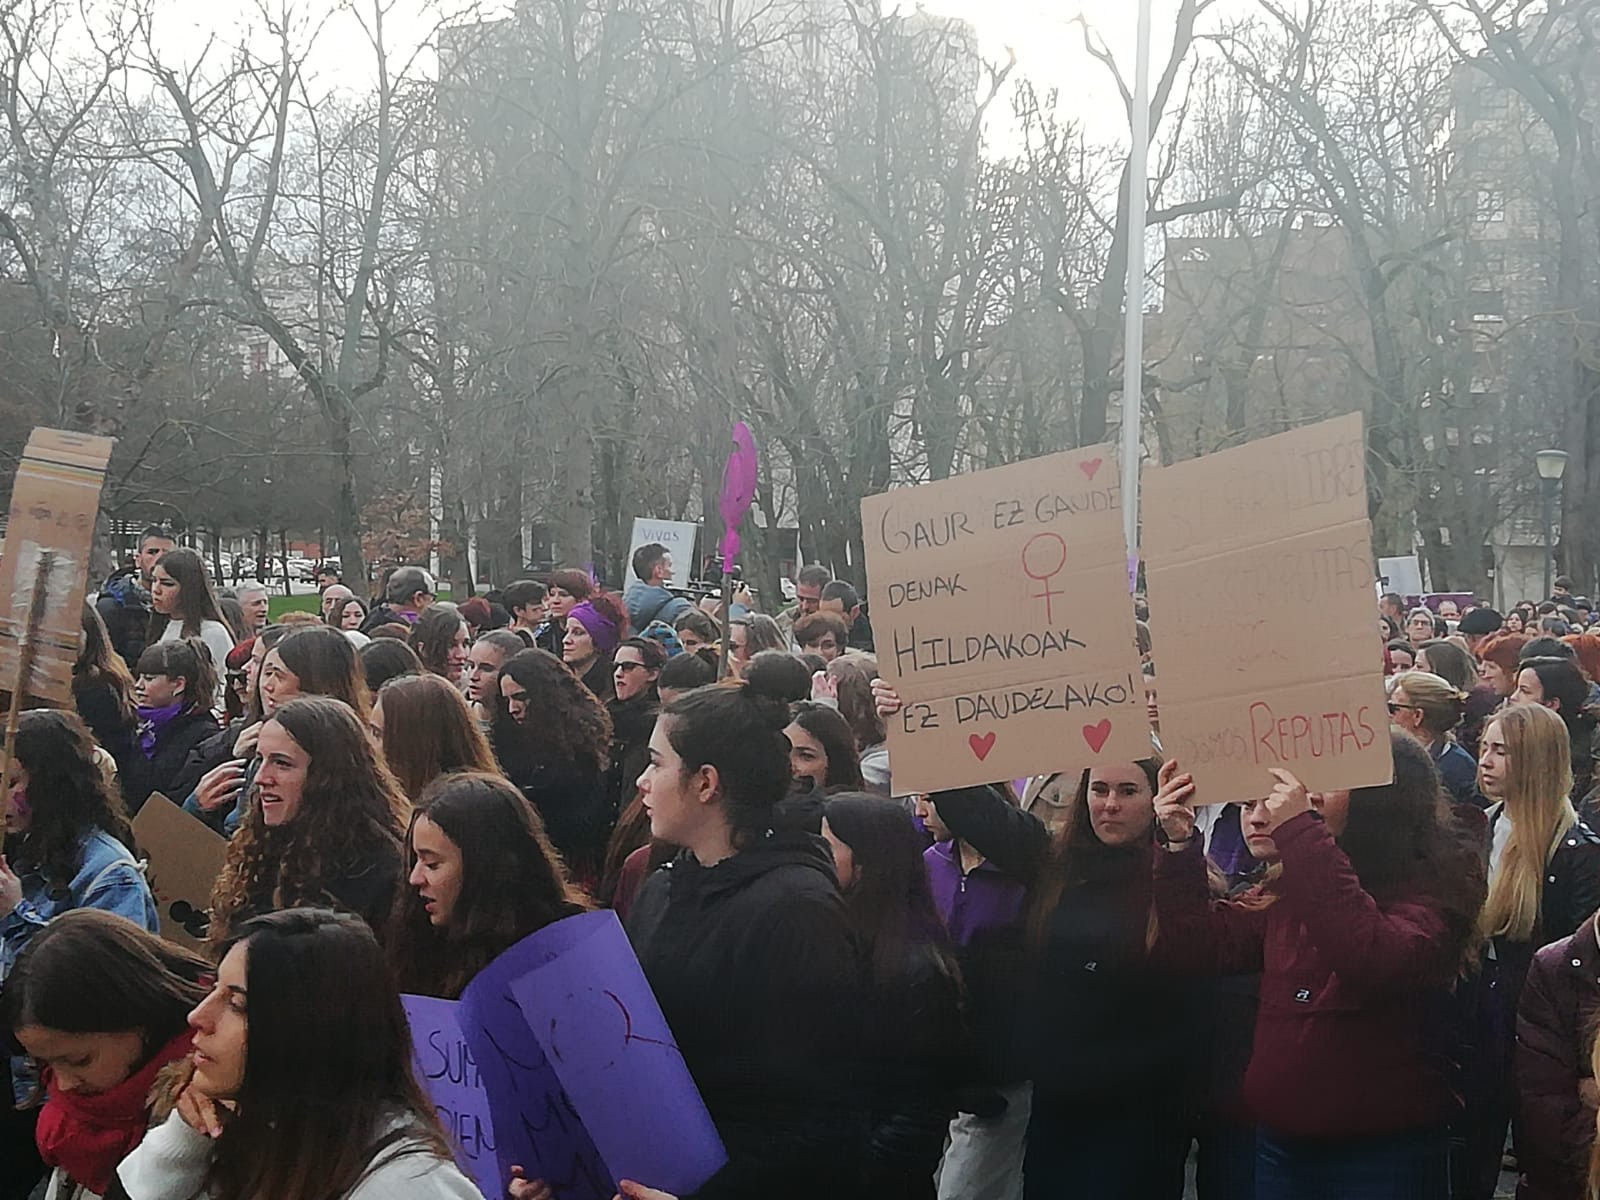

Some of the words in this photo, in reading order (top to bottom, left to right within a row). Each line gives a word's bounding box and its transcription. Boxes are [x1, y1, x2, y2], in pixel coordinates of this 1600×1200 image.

[881, 504, 974, 554] GAUR
[994, 500, 1025, 529] EZ
[888, 573, 968, 608] DENAK
[893, 625, 1087, 678] HILDAKOAK
[903, 703, 939, 733] EZ
[955, 673, 1136, 724] DAUDELAKO!
[1249, 701, 1376, 765] REPUTAS
